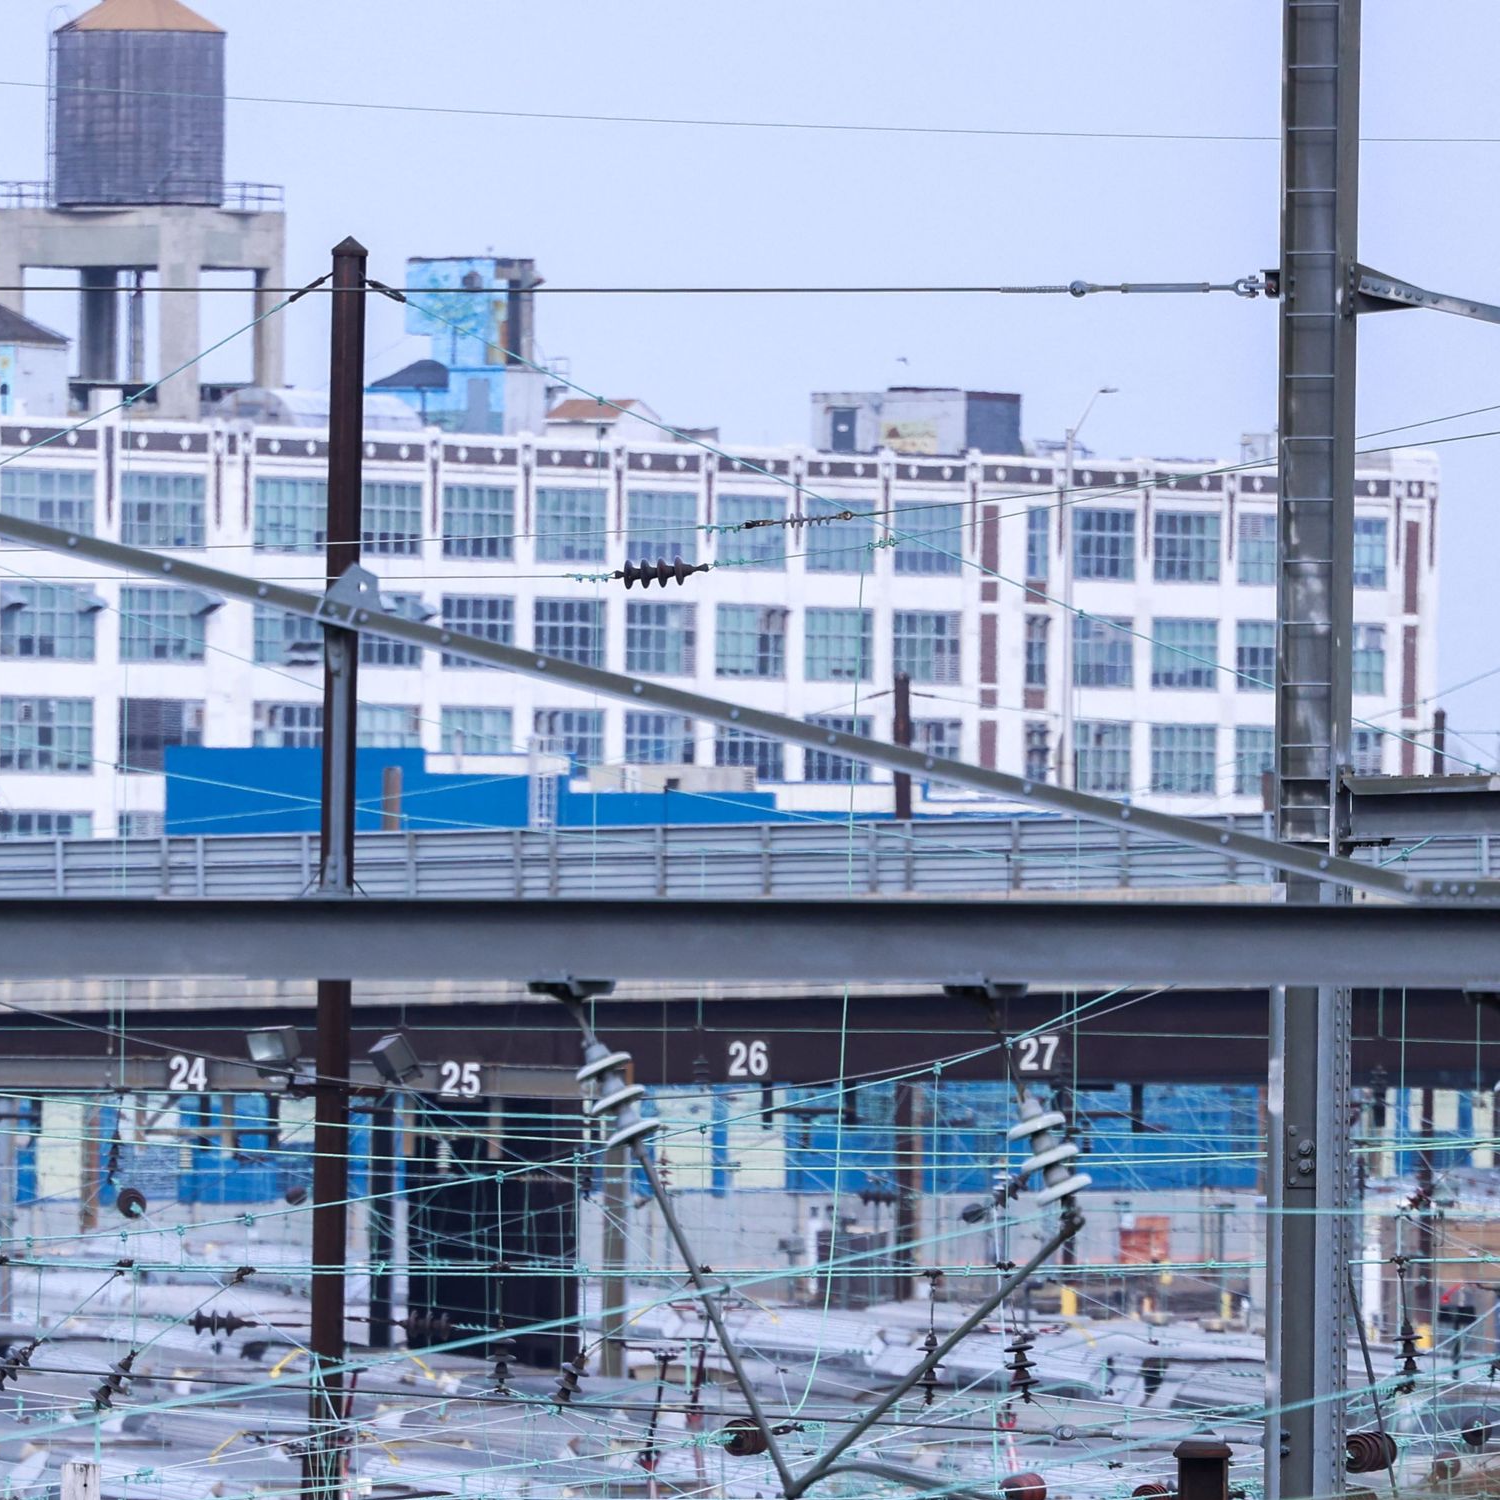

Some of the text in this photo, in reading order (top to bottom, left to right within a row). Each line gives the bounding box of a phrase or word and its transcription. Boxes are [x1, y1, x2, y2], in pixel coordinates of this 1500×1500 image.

[728, 1040, 768, 1076] 26
[1019, 1036, 1059, 1071] 27
[169, 1055, 207, 1091] 24
[441, 1060, 481, 1098] 25
